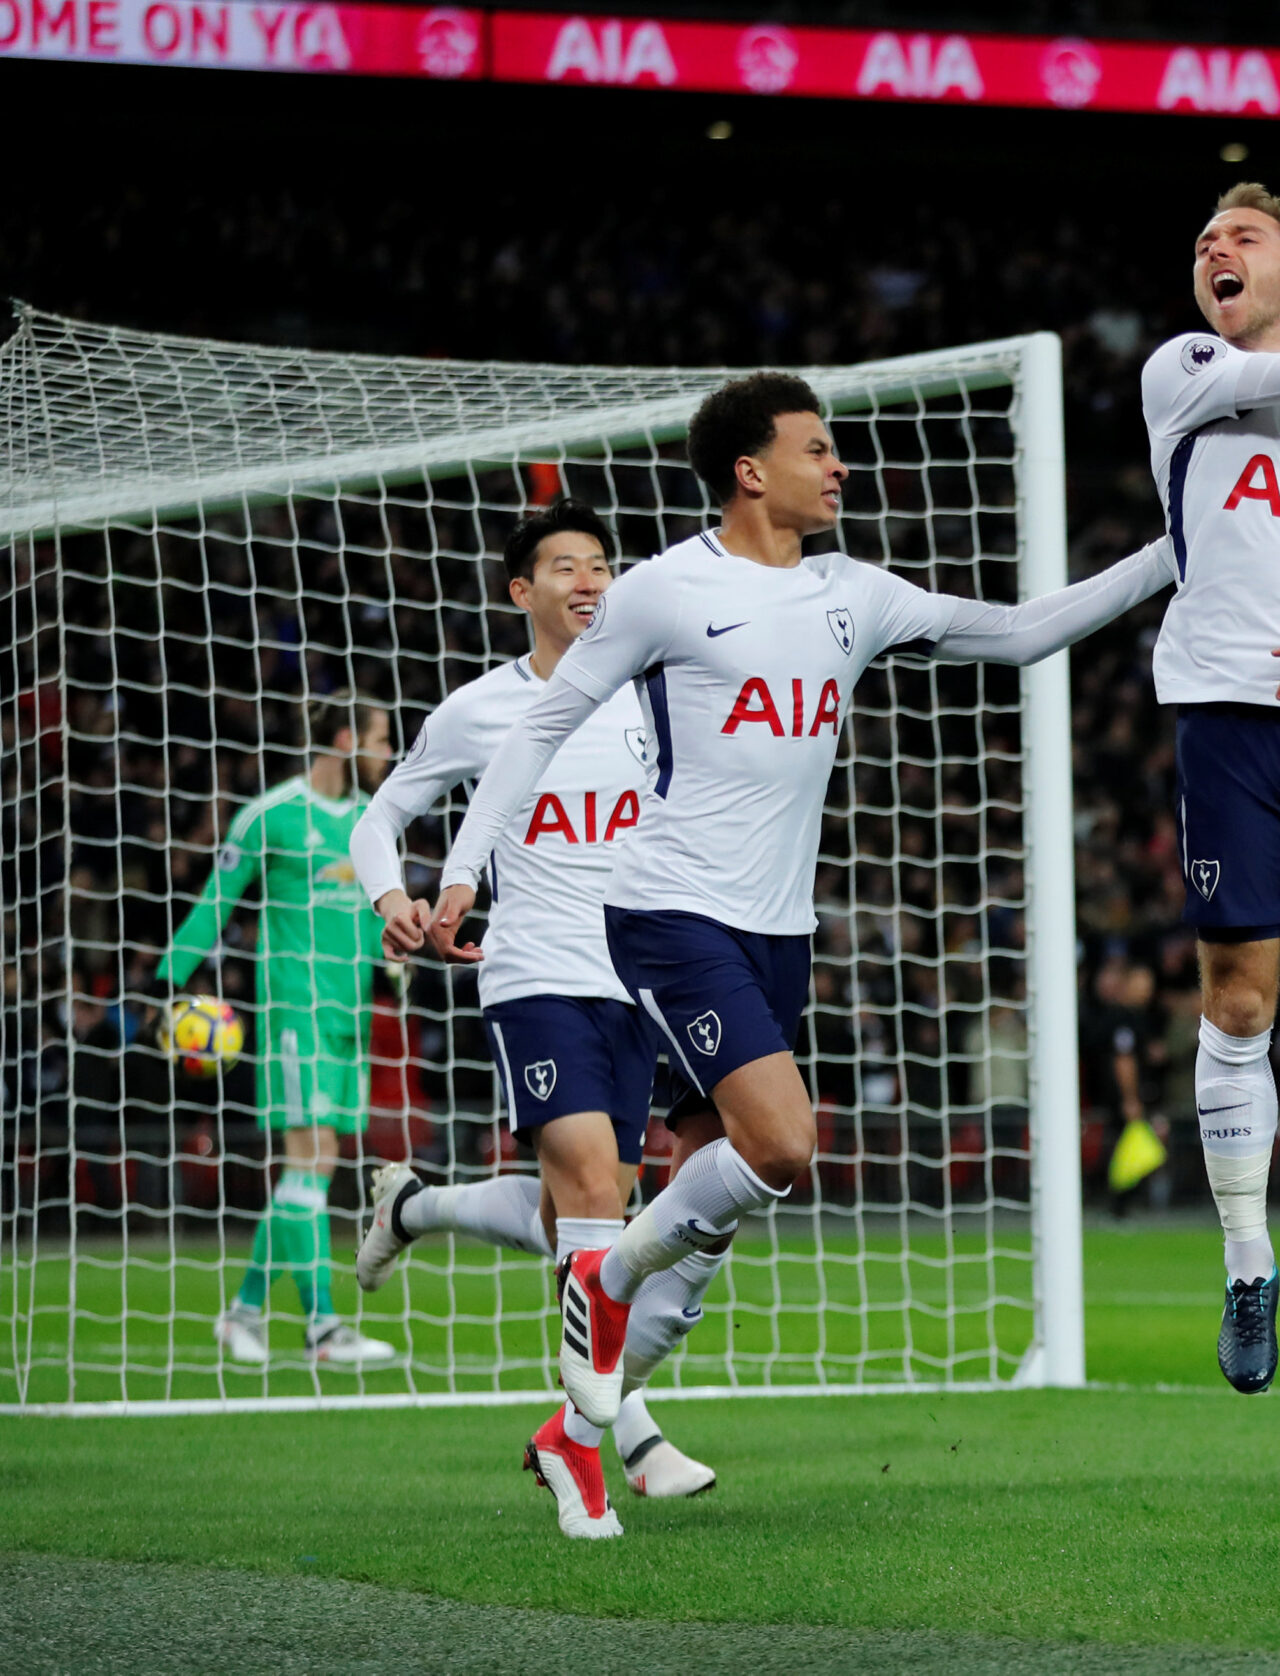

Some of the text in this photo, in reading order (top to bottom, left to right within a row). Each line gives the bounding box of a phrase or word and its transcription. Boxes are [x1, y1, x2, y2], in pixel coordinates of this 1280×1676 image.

[142, 3, 229, 61] ON
[547, 17, 677, 86] AIA
[856, 33, 984, 100] AIA
[720, 676, 841, 737] AIA
[523, 789, 640, 845] AIA
[1202, 1126, 1252, 1140] SPURS
